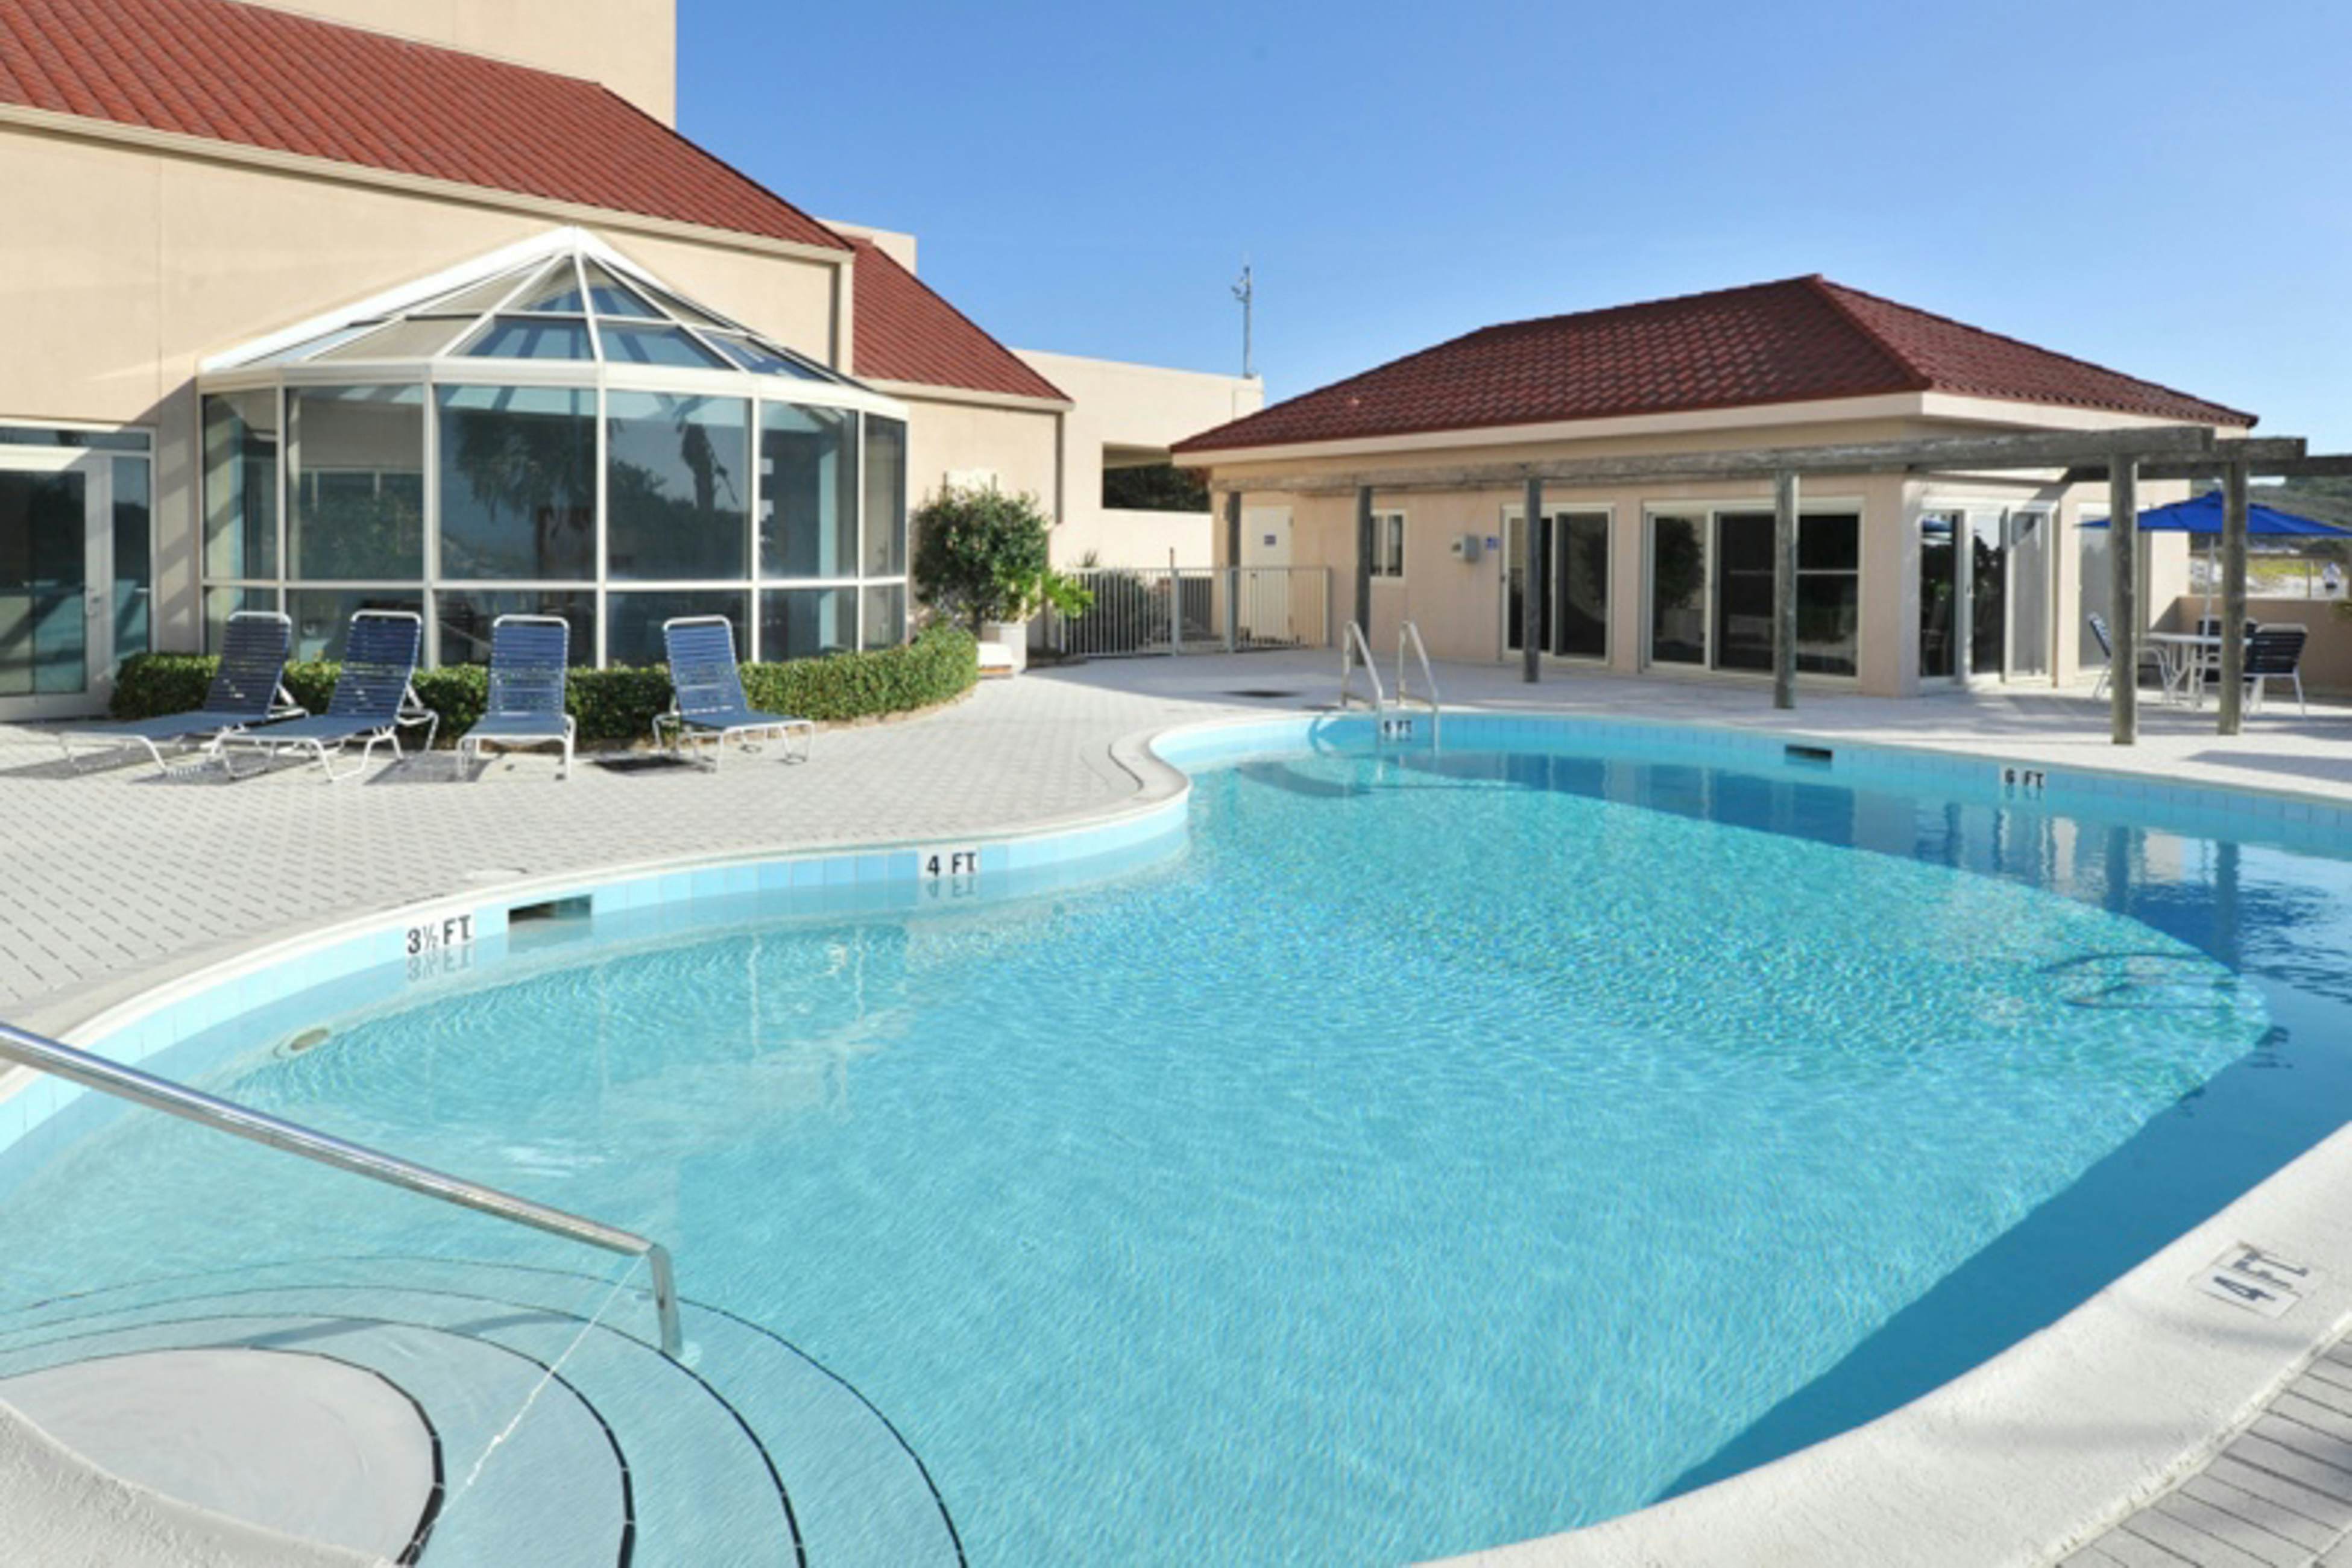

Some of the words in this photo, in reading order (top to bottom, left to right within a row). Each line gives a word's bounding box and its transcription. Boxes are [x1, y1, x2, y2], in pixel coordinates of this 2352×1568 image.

[2023, 770, 2045, 790] FT
[927, 855, 941, 877] 4
[951, 852, 976, 875] FT
[443, 915, 471, 945] FT
[2233, 1245, 2309, 1291] FT
[2212, 1275, 2277, 1302] 4
